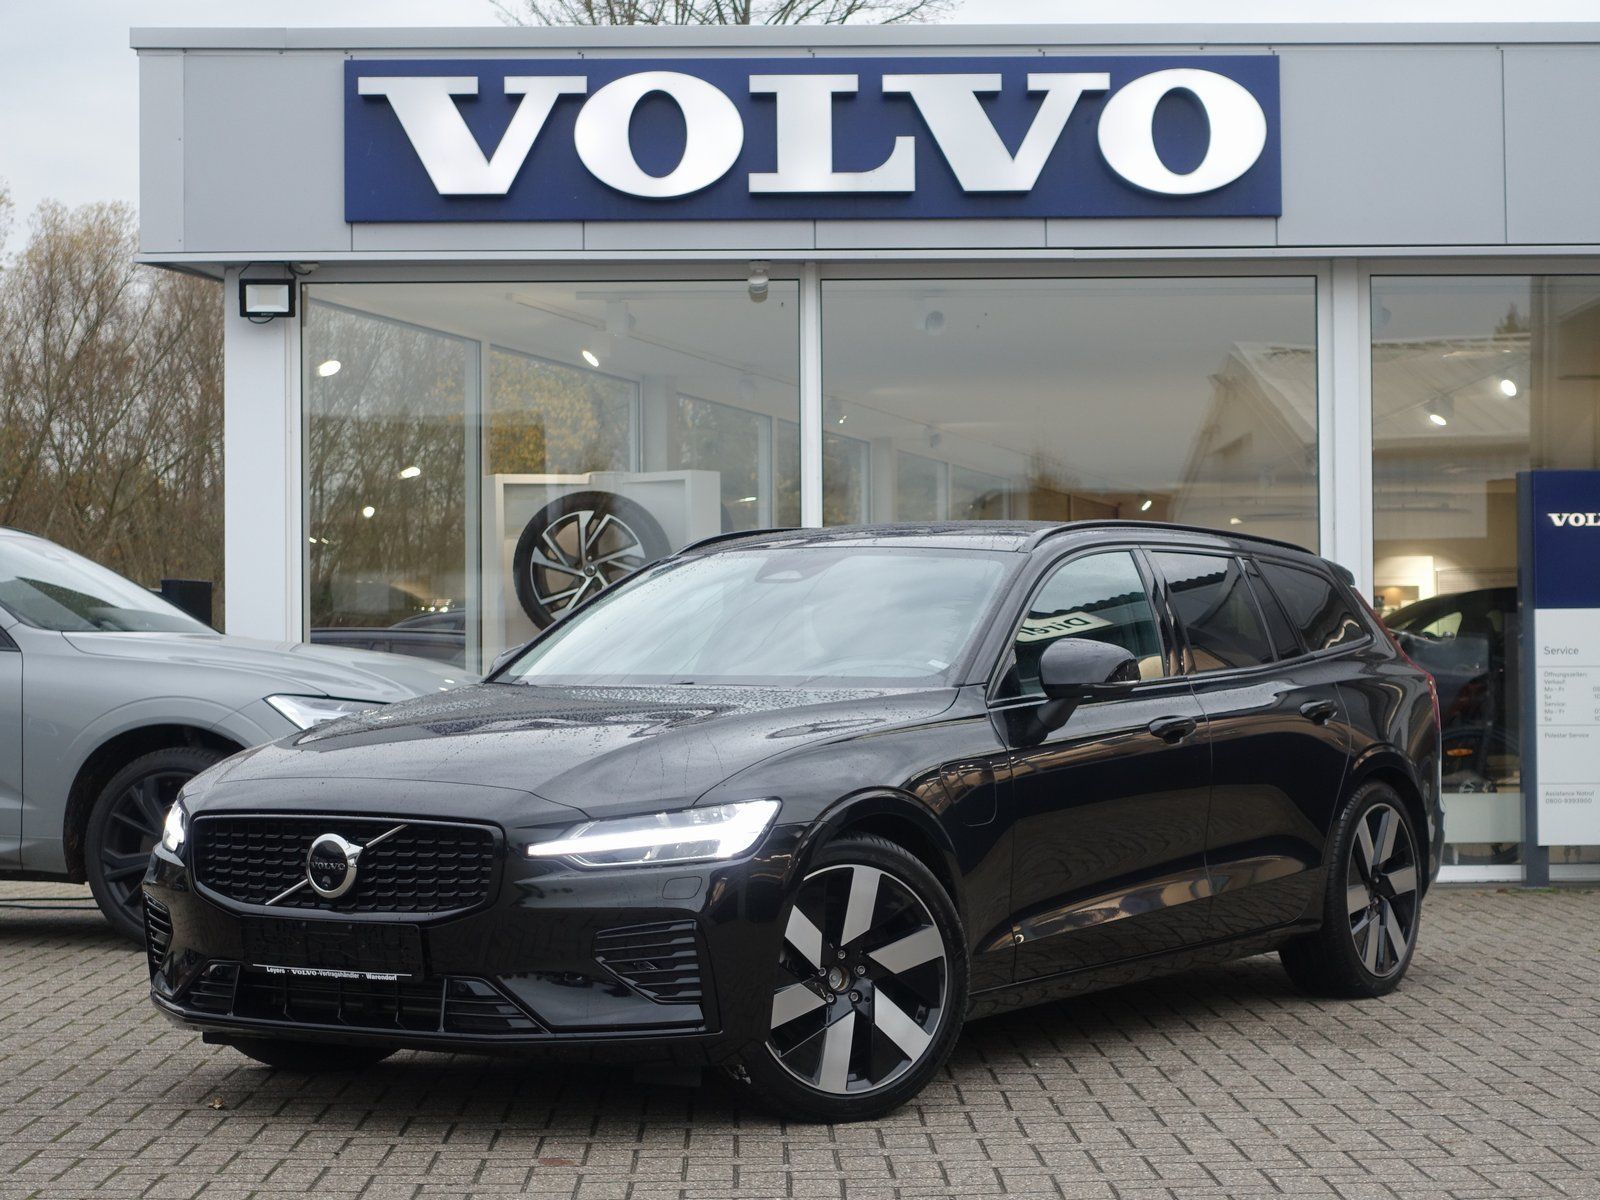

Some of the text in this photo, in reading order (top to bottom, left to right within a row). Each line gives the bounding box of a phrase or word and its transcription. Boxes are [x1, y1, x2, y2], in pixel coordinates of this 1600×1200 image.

[358, 69, 1267, 197] VOLVO
[1547, 512, 1600, 527] VOL
[1543, 645, 1579, 655] Service
[311, 861, 345, 871] VOLVO
